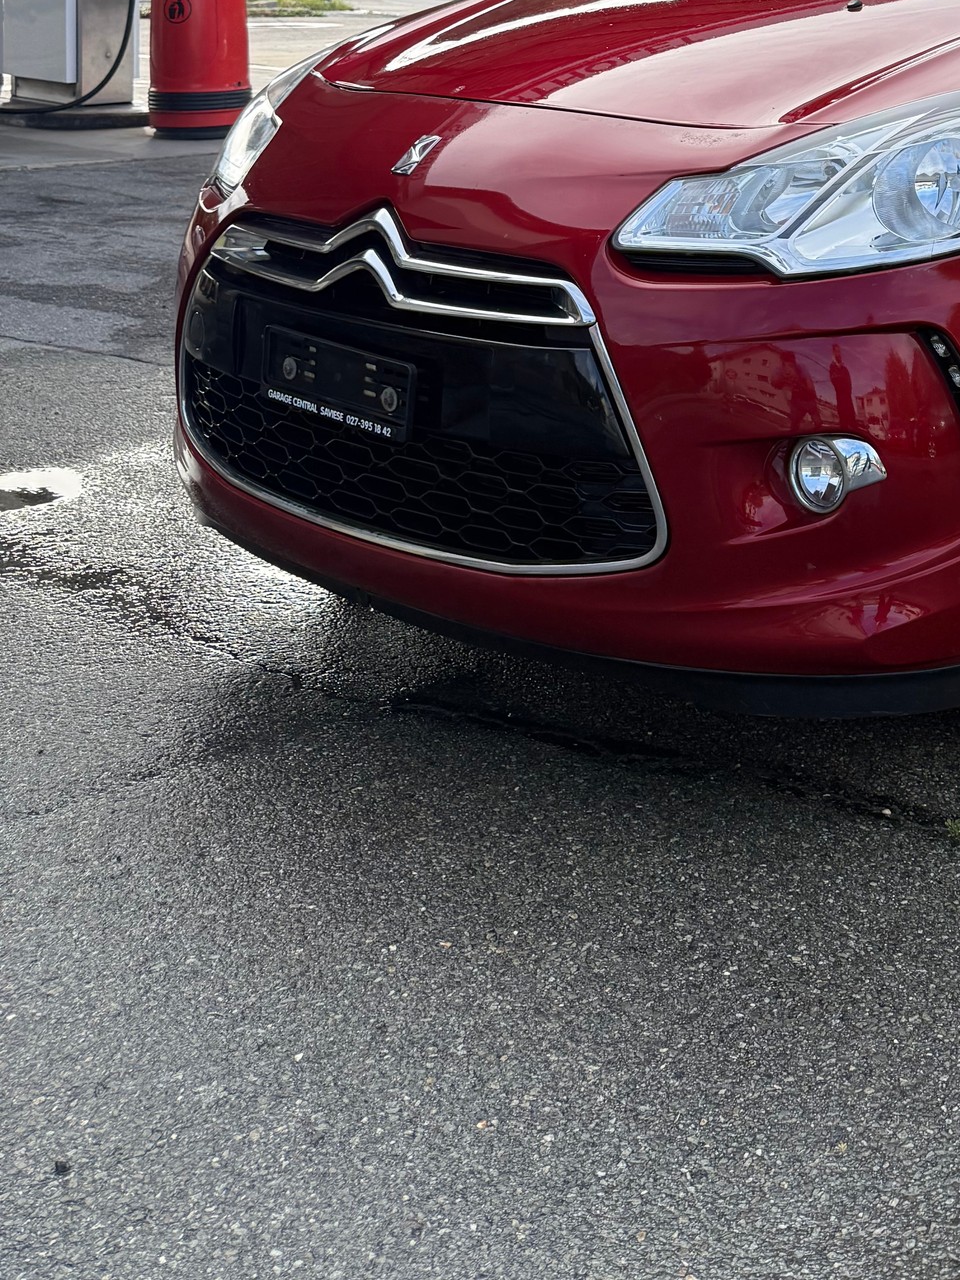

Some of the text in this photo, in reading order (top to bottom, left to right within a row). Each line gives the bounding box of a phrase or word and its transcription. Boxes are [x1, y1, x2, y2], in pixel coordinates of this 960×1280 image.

[267, 389, 392, 438] GARAGE CENTRAL SAVIESE 027-395 18 42
